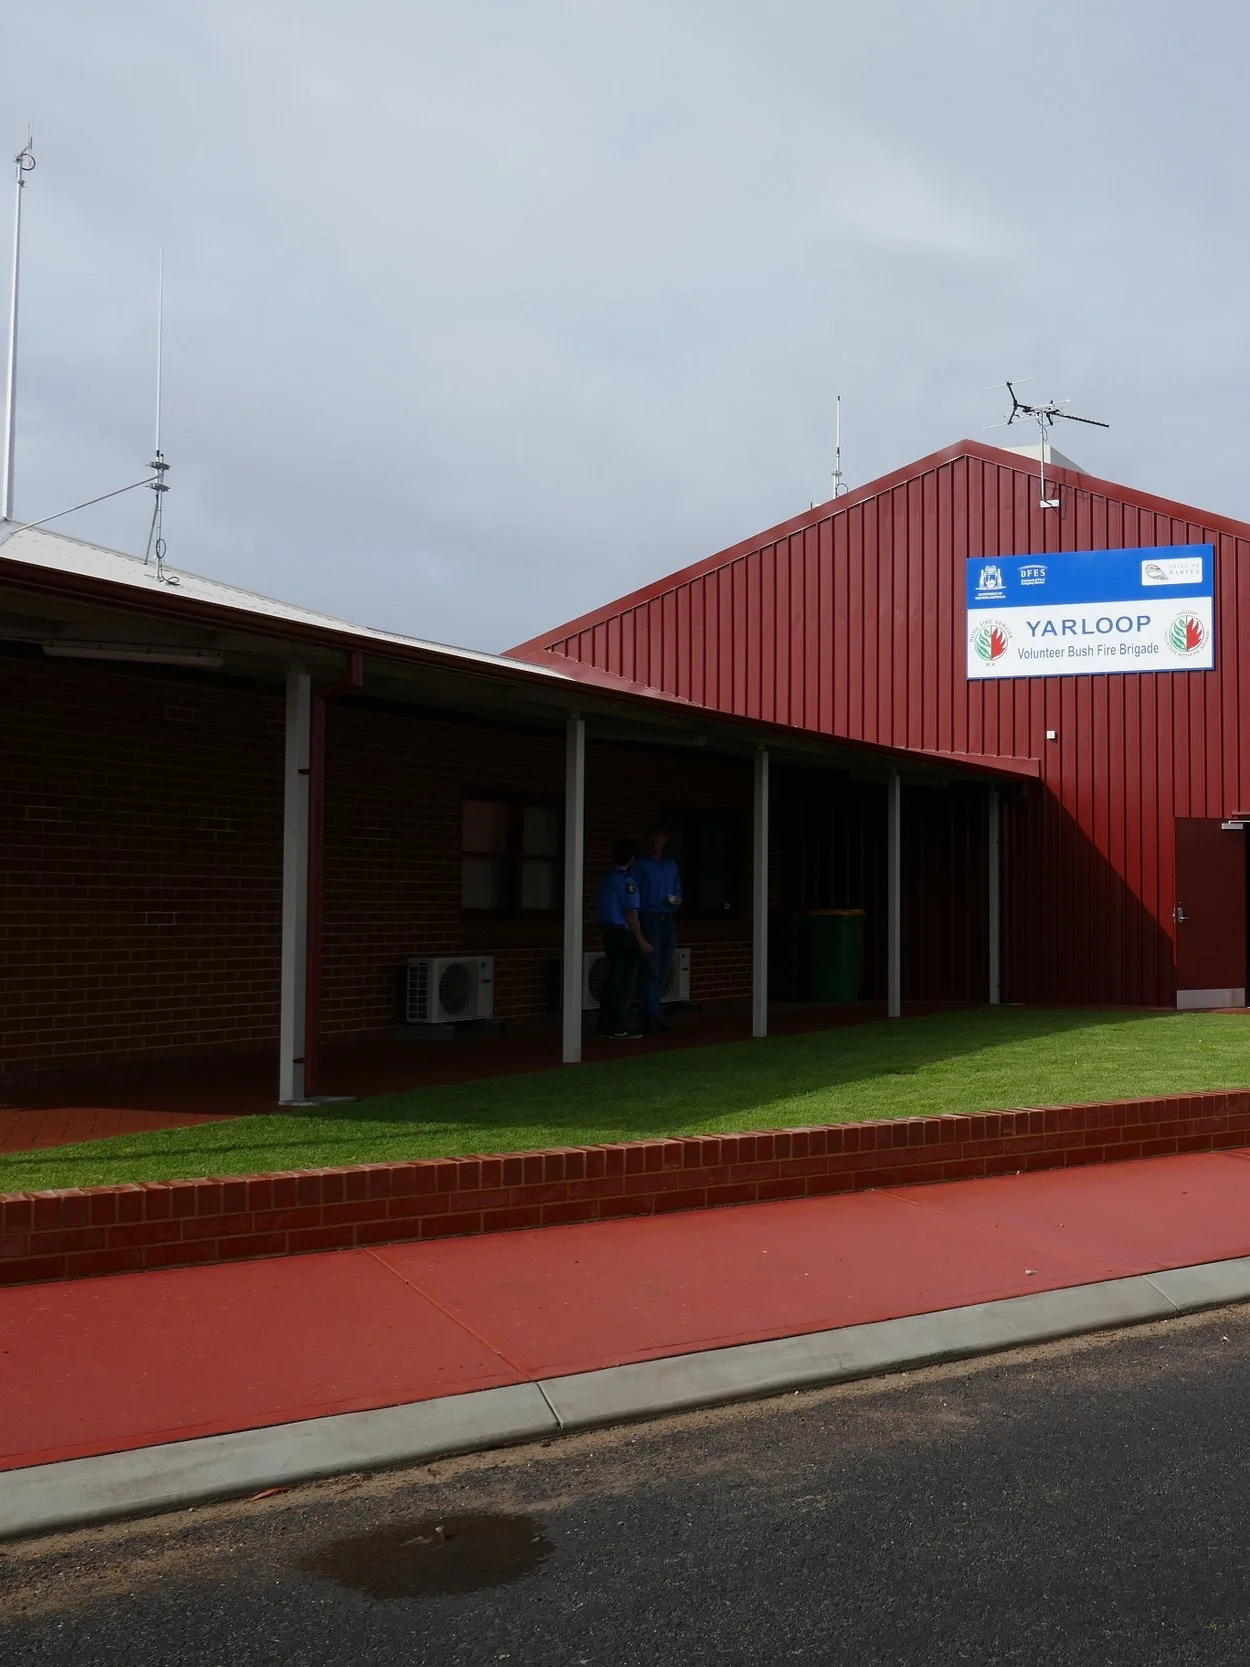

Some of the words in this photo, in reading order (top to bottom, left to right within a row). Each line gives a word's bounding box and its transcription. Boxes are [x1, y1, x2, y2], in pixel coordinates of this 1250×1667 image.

[1020, 568, 1046, 578] DFES
[1026, 615, 1151, 637] YARLOOP
[1018, 647, 1065, 659] Volunteer
[1068, 645, 1094, 657] Bush
[1097, 643, 1117, 656] Fire
[1119, 642, 1160, 658] Brigade
